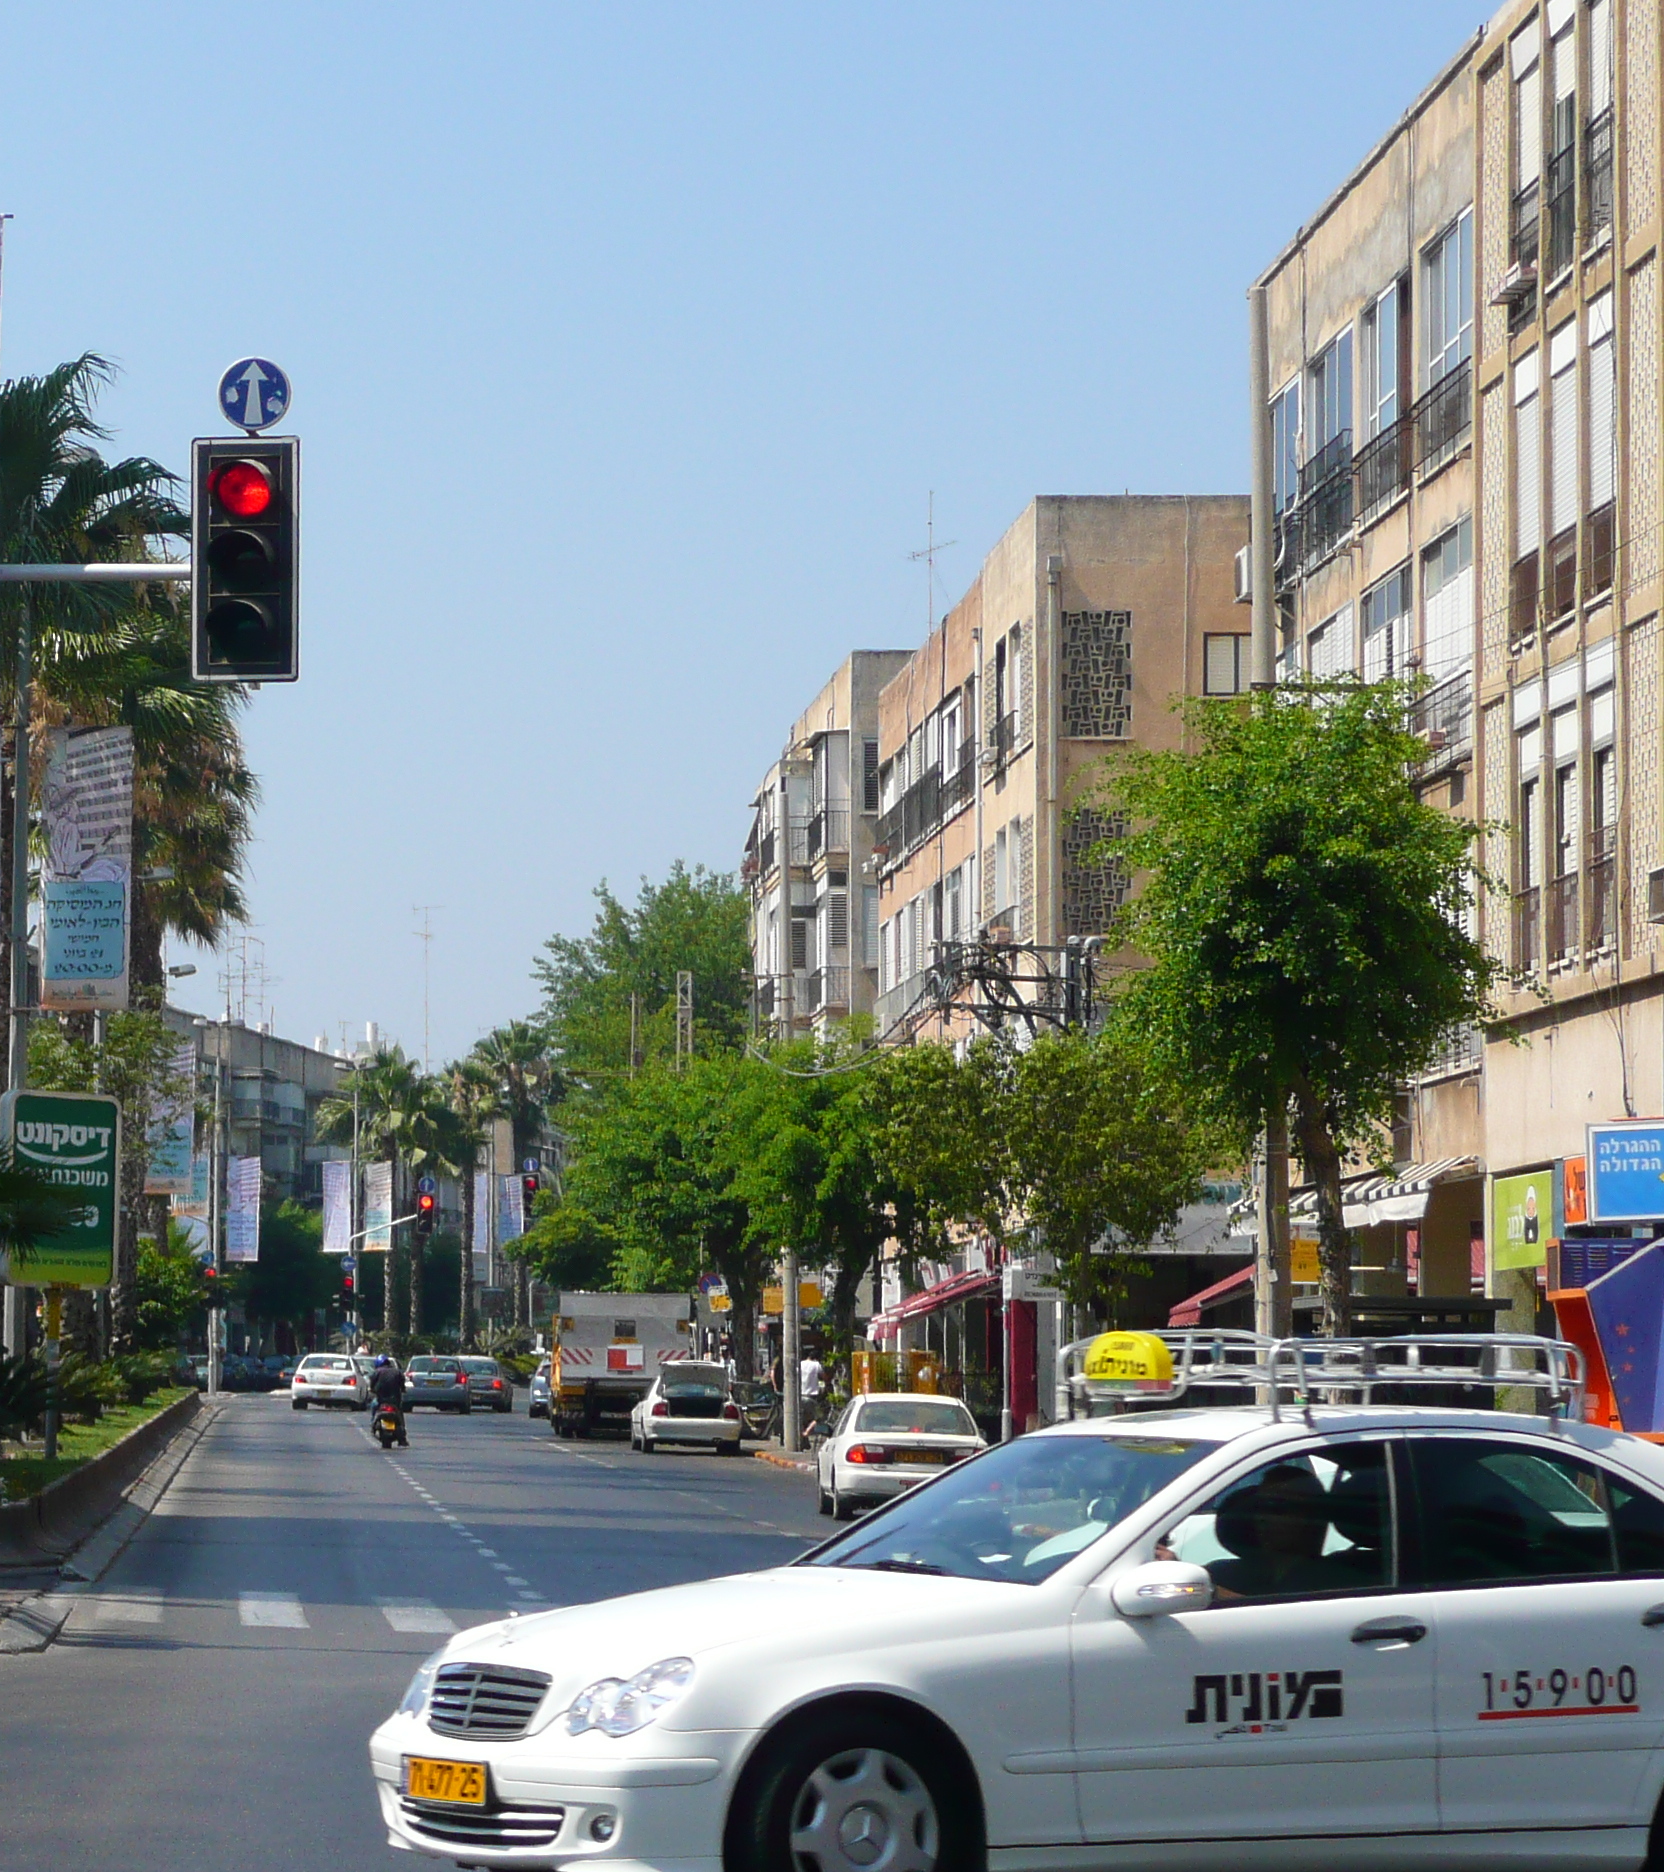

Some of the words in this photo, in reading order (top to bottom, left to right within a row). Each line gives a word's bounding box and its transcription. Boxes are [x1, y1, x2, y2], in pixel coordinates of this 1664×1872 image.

[16, 1121, 112, 1152] דיסקונט
[1599, 1138, 1661, 1154] ההגרלה
[1600, 1156, 1661, 1172] הגדולה
[40, 1168, 109, 1187] משכנת
[1184, 1669, 1343, 1724] מונית
